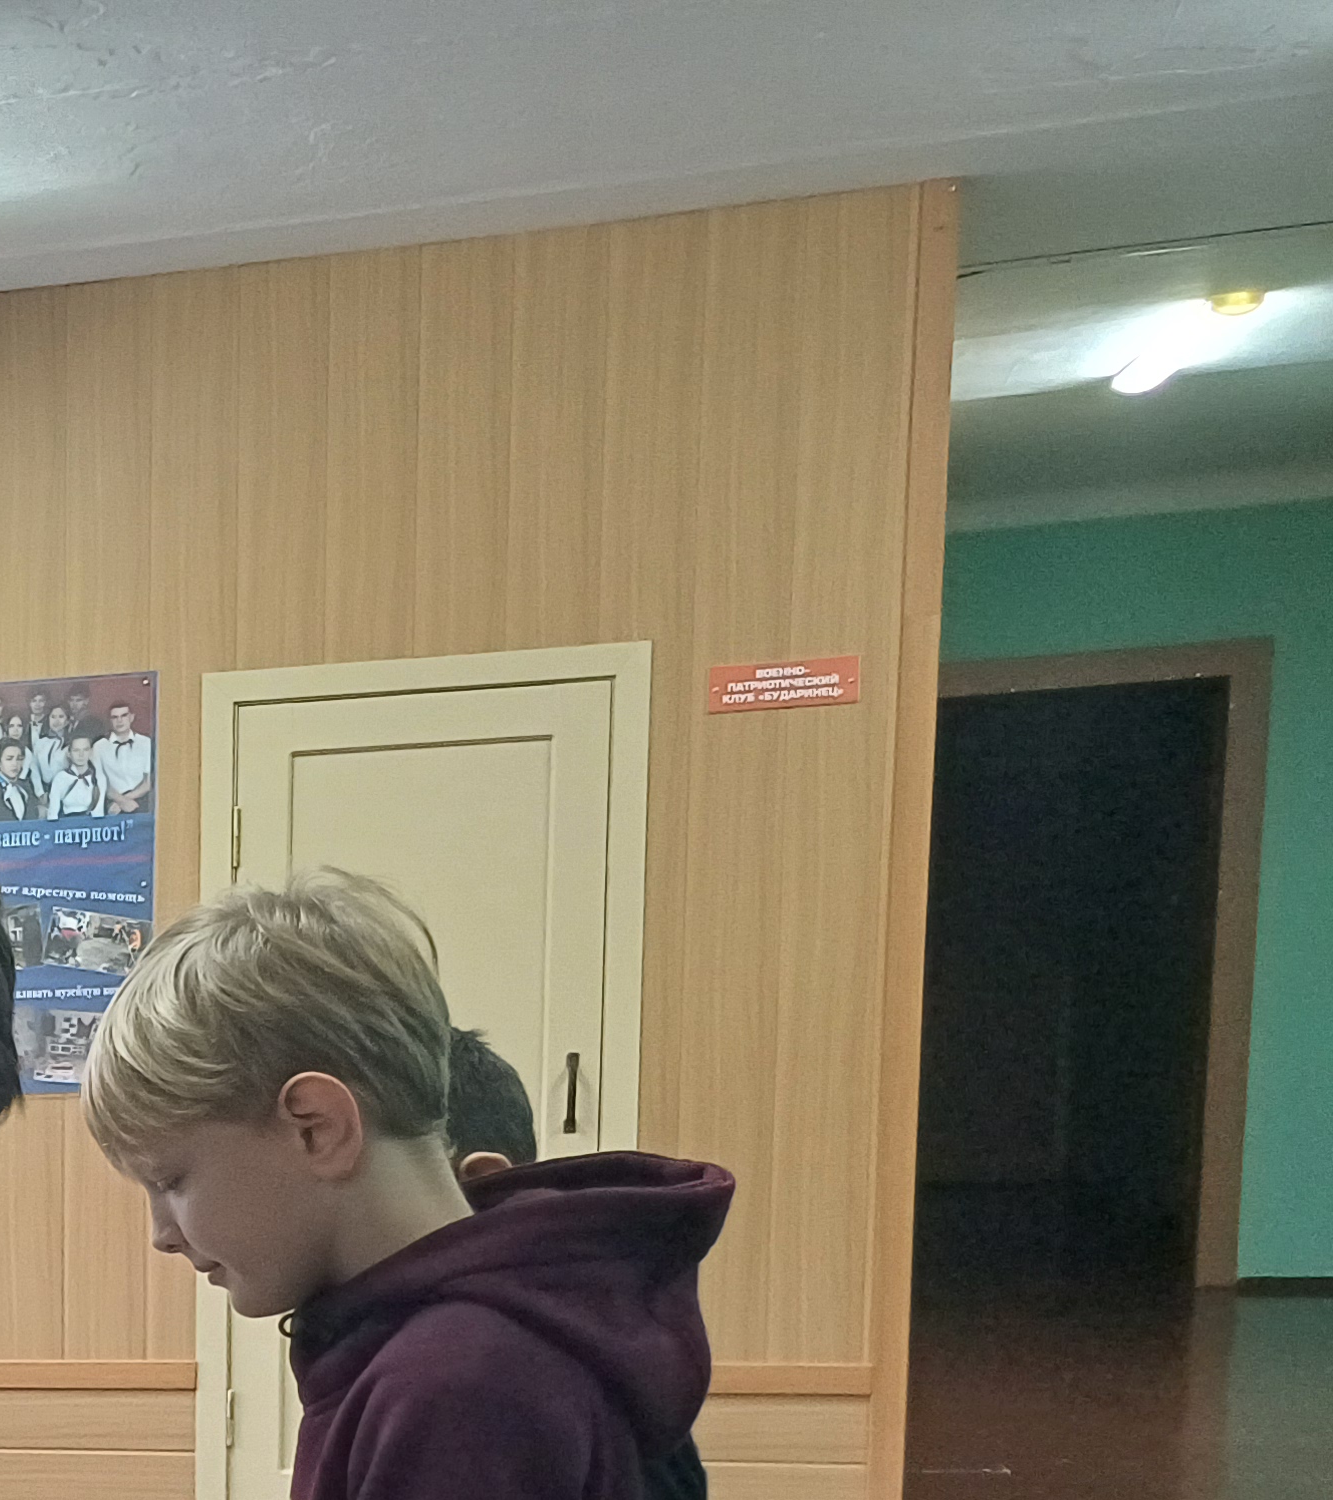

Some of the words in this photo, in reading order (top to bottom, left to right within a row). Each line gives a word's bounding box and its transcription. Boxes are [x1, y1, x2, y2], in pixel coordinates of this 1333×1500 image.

[756, 666, 810, 678] ВОЕННО-
[727, 674, 839, 692] ПАТРИОТИЧЕСКИЙ
[722, 693, 755, 704] КЛУБ
[21, 886, 86, 900] адресную
[90, 891, 145, 904] помощь
